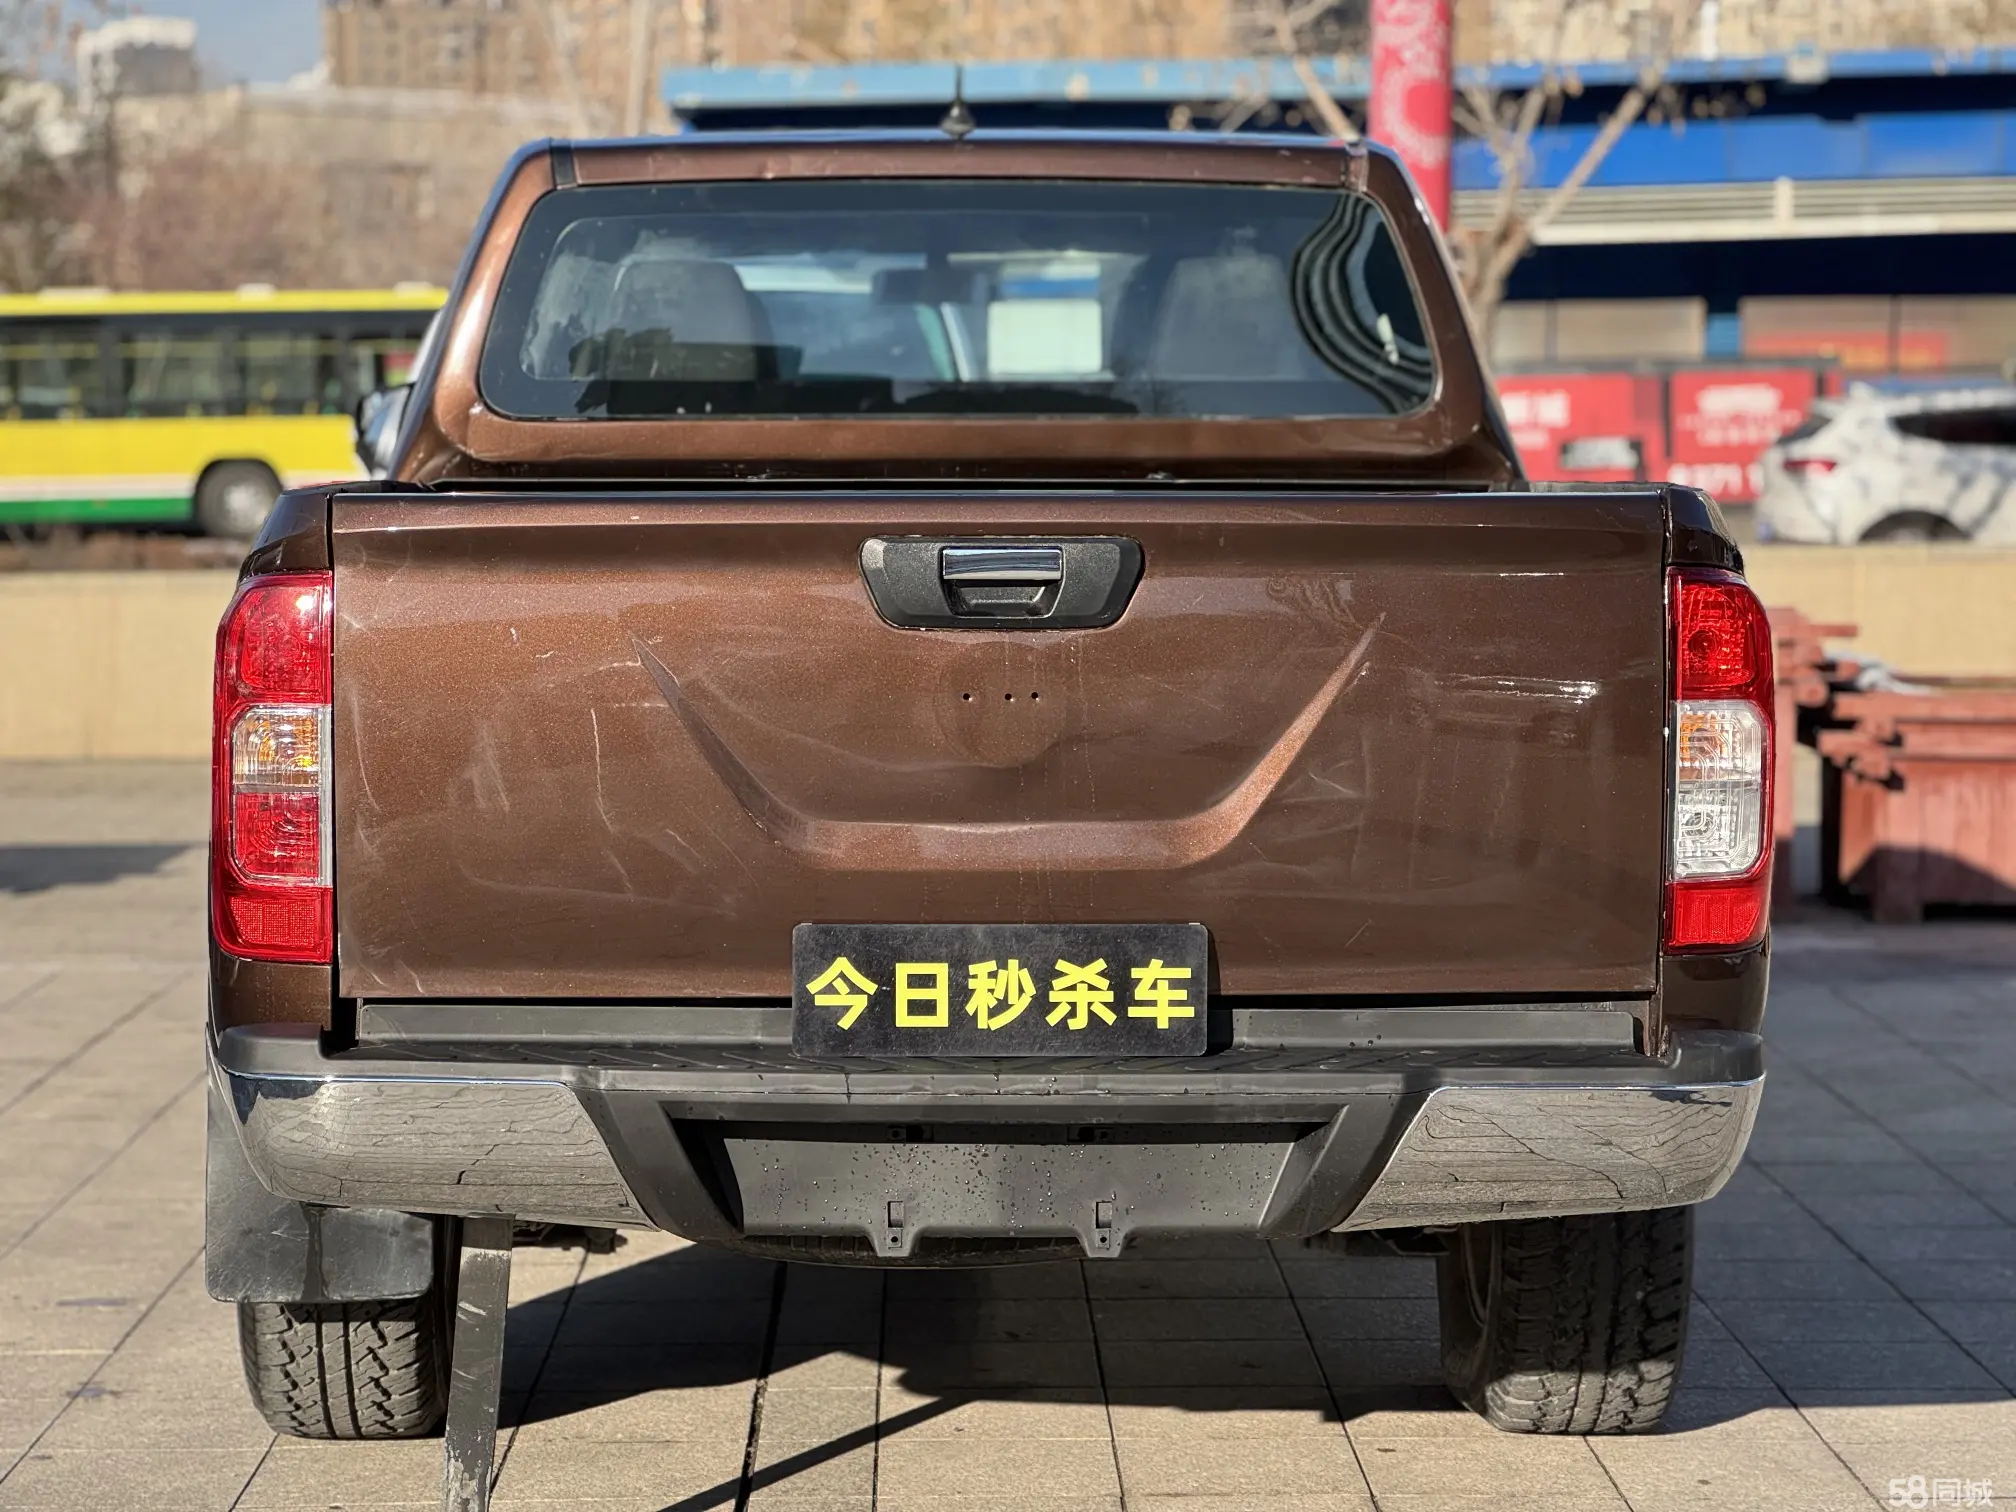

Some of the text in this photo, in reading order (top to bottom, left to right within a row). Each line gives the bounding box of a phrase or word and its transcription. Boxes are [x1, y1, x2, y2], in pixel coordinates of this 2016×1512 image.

[806, 956, 1195, 1030] 今日秒杀车
